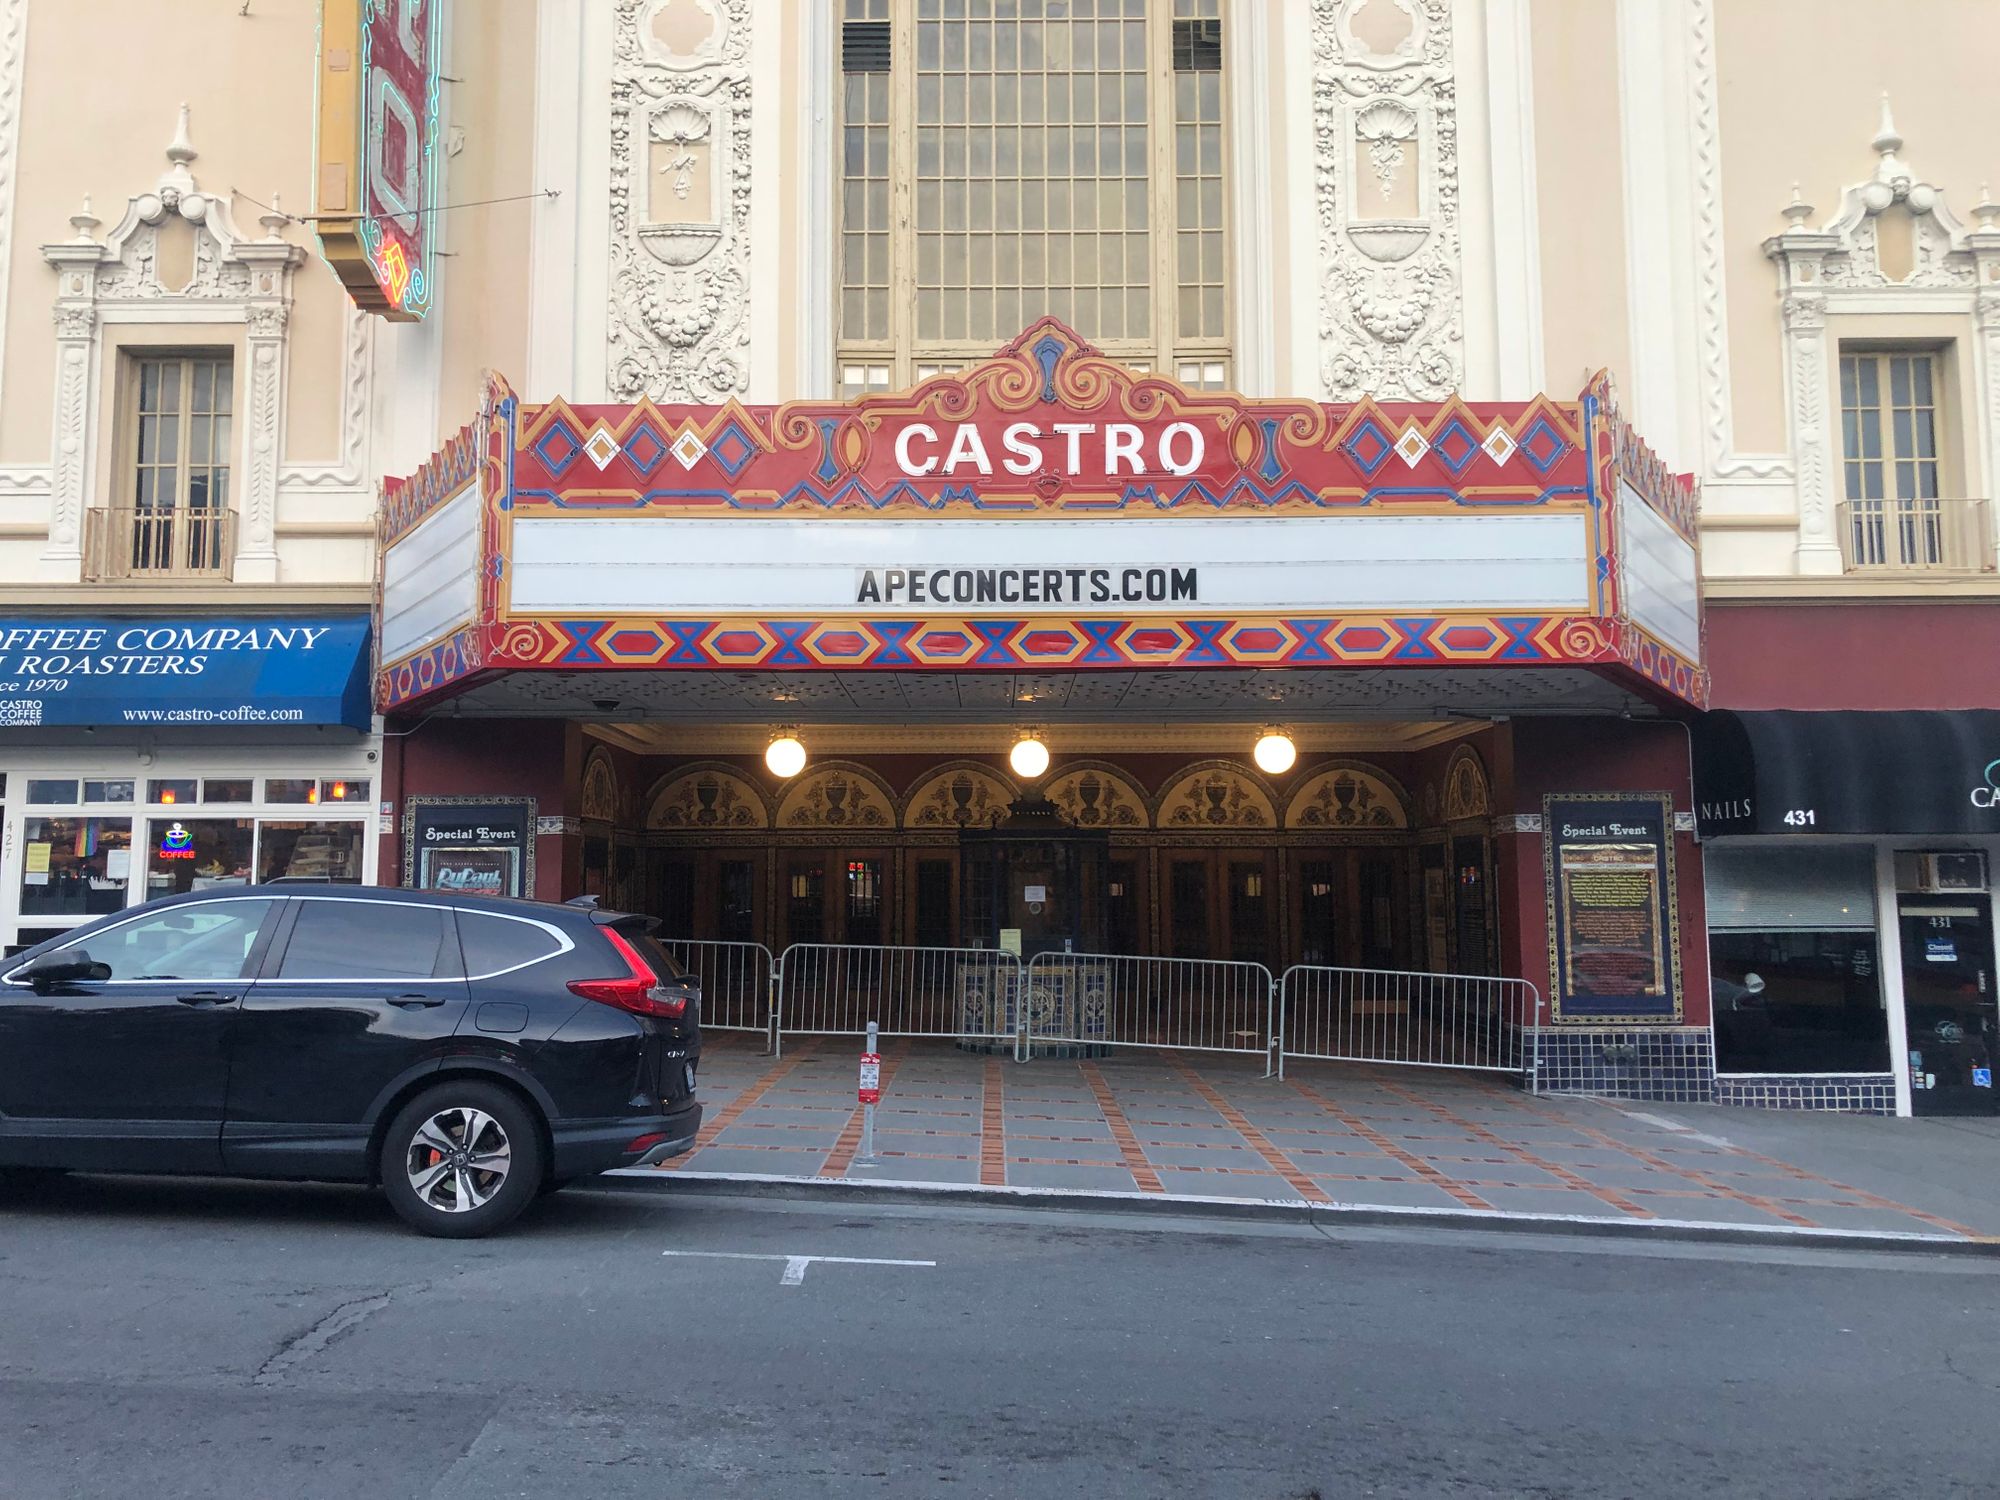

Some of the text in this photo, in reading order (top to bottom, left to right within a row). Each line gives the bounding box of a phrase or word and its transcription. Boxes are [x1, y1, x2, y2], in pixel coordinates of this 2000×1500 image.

[894, 421, 1206, 477] CASTRO
[857, 568, 1198, 603] APECONCERTS.COM
[0, 628, 330, 650] FFEE COMPANY
[14, 655, 208, 675] ROASTERS
[24, 679, 69, 692] 1970
[0, 700, 43, 710] CASTRO
[0, 709, 42, 719] COFFEE
[123, 705, 303, 721] www.castro-coffee.com
[0, 719, 42, 727] COMPANY
[1702, 798, 1751, 820] NAILS
[1783, 810, 1816, 825] 431
[425, 827, 516, 841] Special Event
[1562, 824, 1647, 837] Special Event
[160, 850, 195, 859] COFFEE
[1929, 917, 1952, 928] 431
